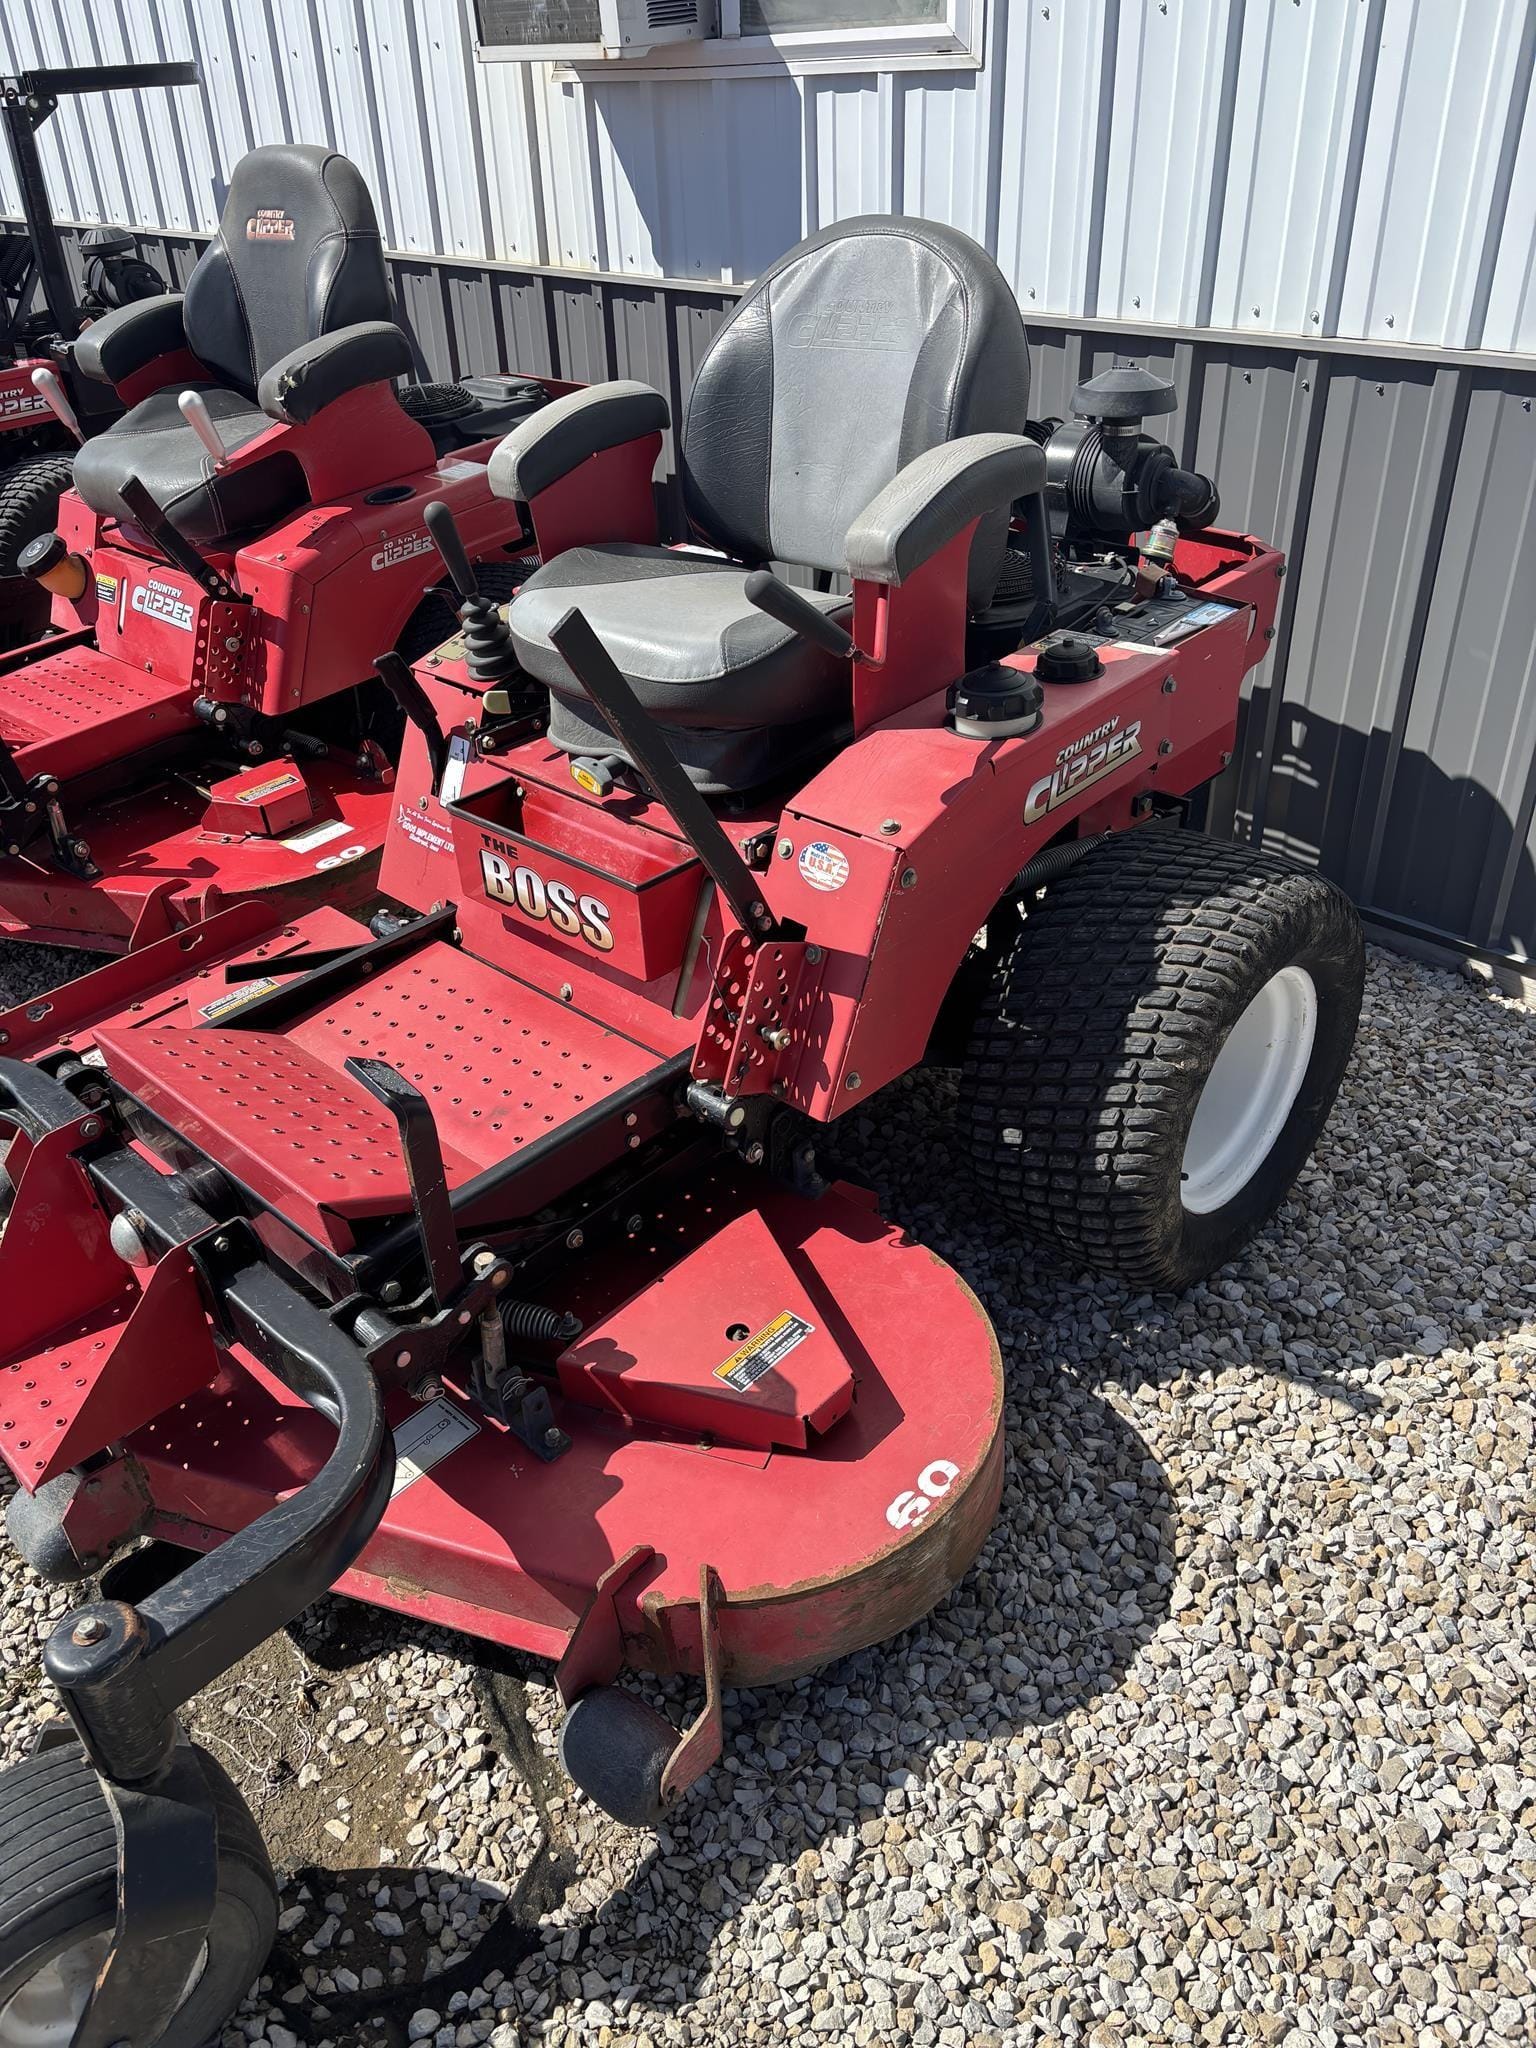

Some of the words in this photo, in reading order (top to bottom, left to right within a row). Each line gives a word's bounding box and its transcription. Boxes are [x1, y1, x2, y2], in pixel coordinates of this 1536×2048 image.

[246, 218, 296, 240] CLIPPER
[371, 535, 436, 571] CLIPPER
[148, 579, 182, 598] COUNTRY
[131, 585, 194, 632] CLIPPER
[1056, 716, 1120, 767] COUNTRY
[1023, 720, 1143, 826] CLIPPER
[315, 845, 366, 870] 60
[481, 833, 519, 861] THE
[479, 848, 615, 953] BOSS
[740, 1327, 776, 1357] WARNING
[885, 1459, 961, 1530] 60
